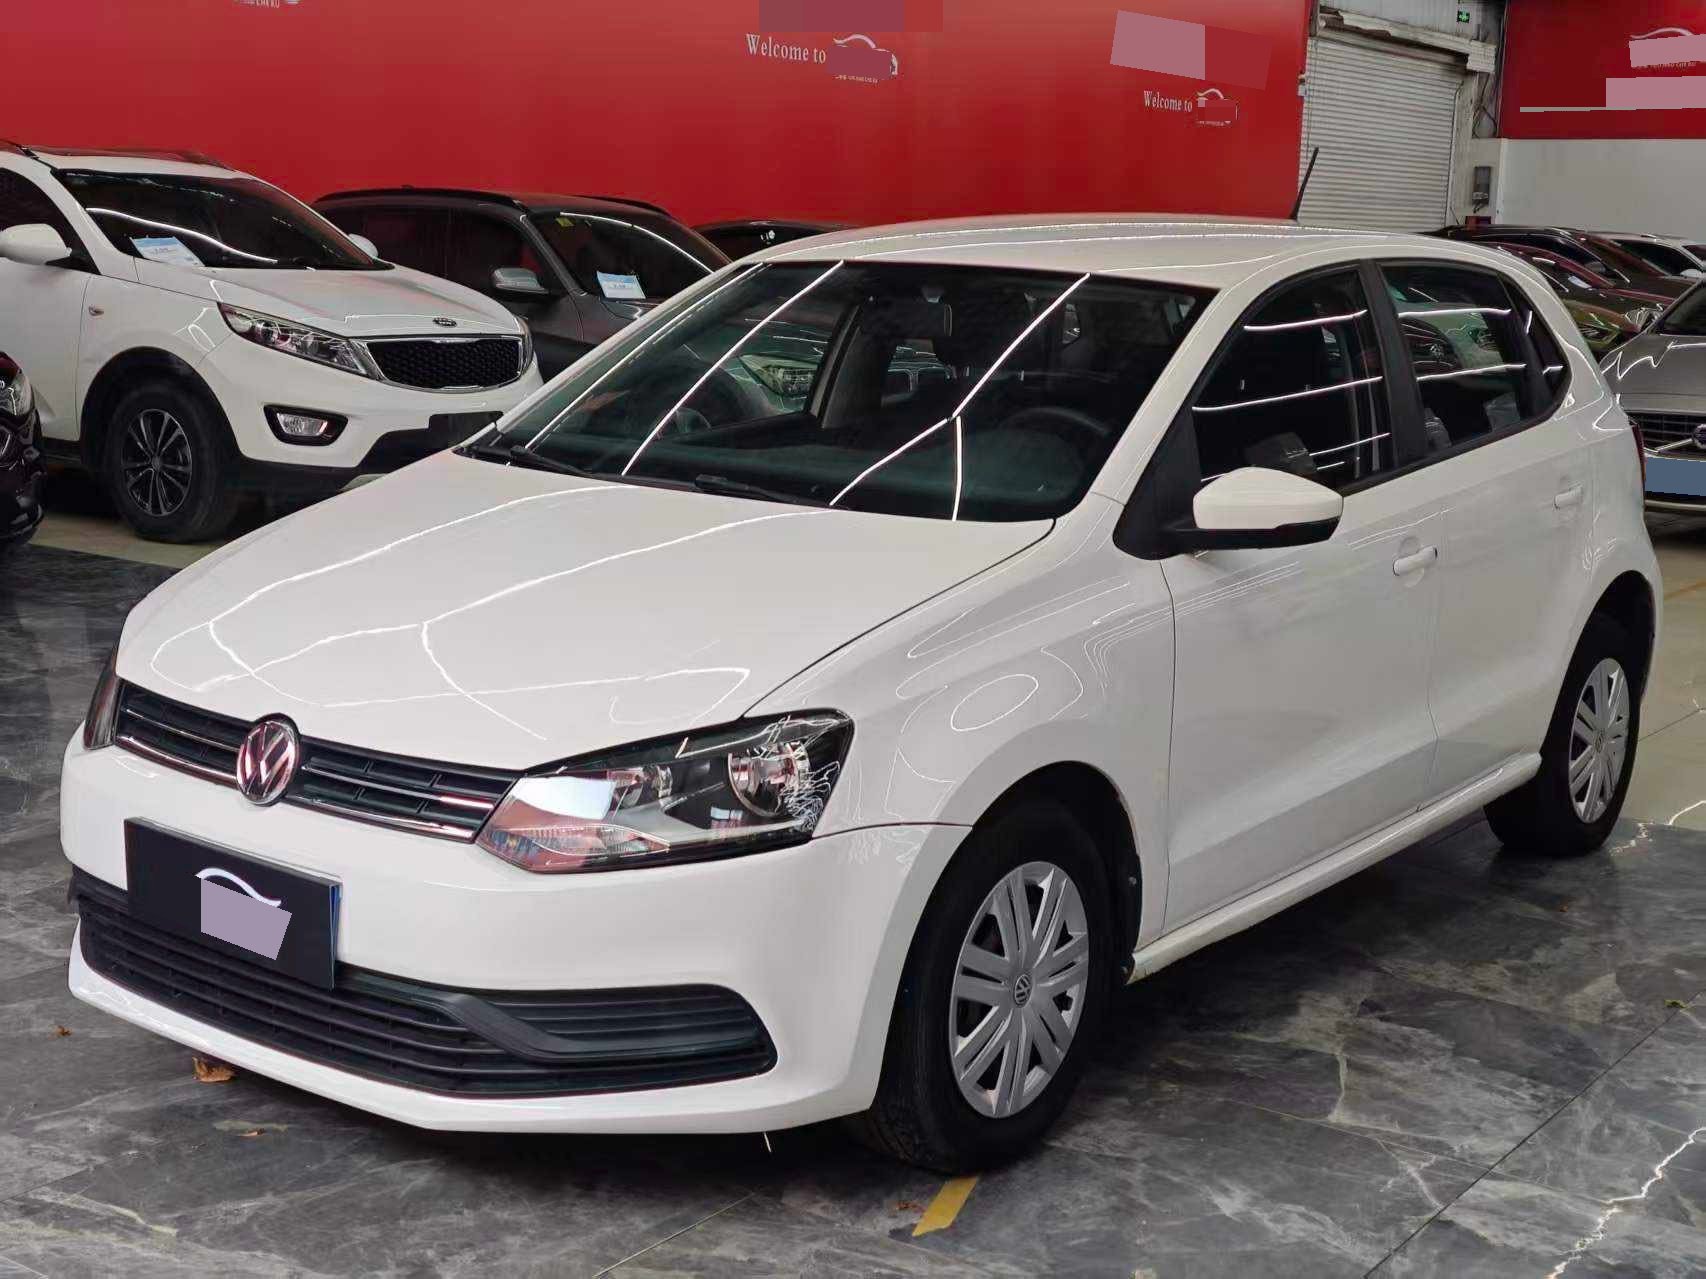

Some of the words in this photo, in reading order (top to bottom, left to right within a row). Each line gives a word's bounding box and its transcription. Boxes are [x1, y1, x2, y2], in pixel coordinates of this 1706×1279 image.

[746, 33, 809, 61] Welcome
[813, 47, 826, 63] to
[1143, 90, 1182, 111] Welcome
[1184, 99, 1193, 112] to
